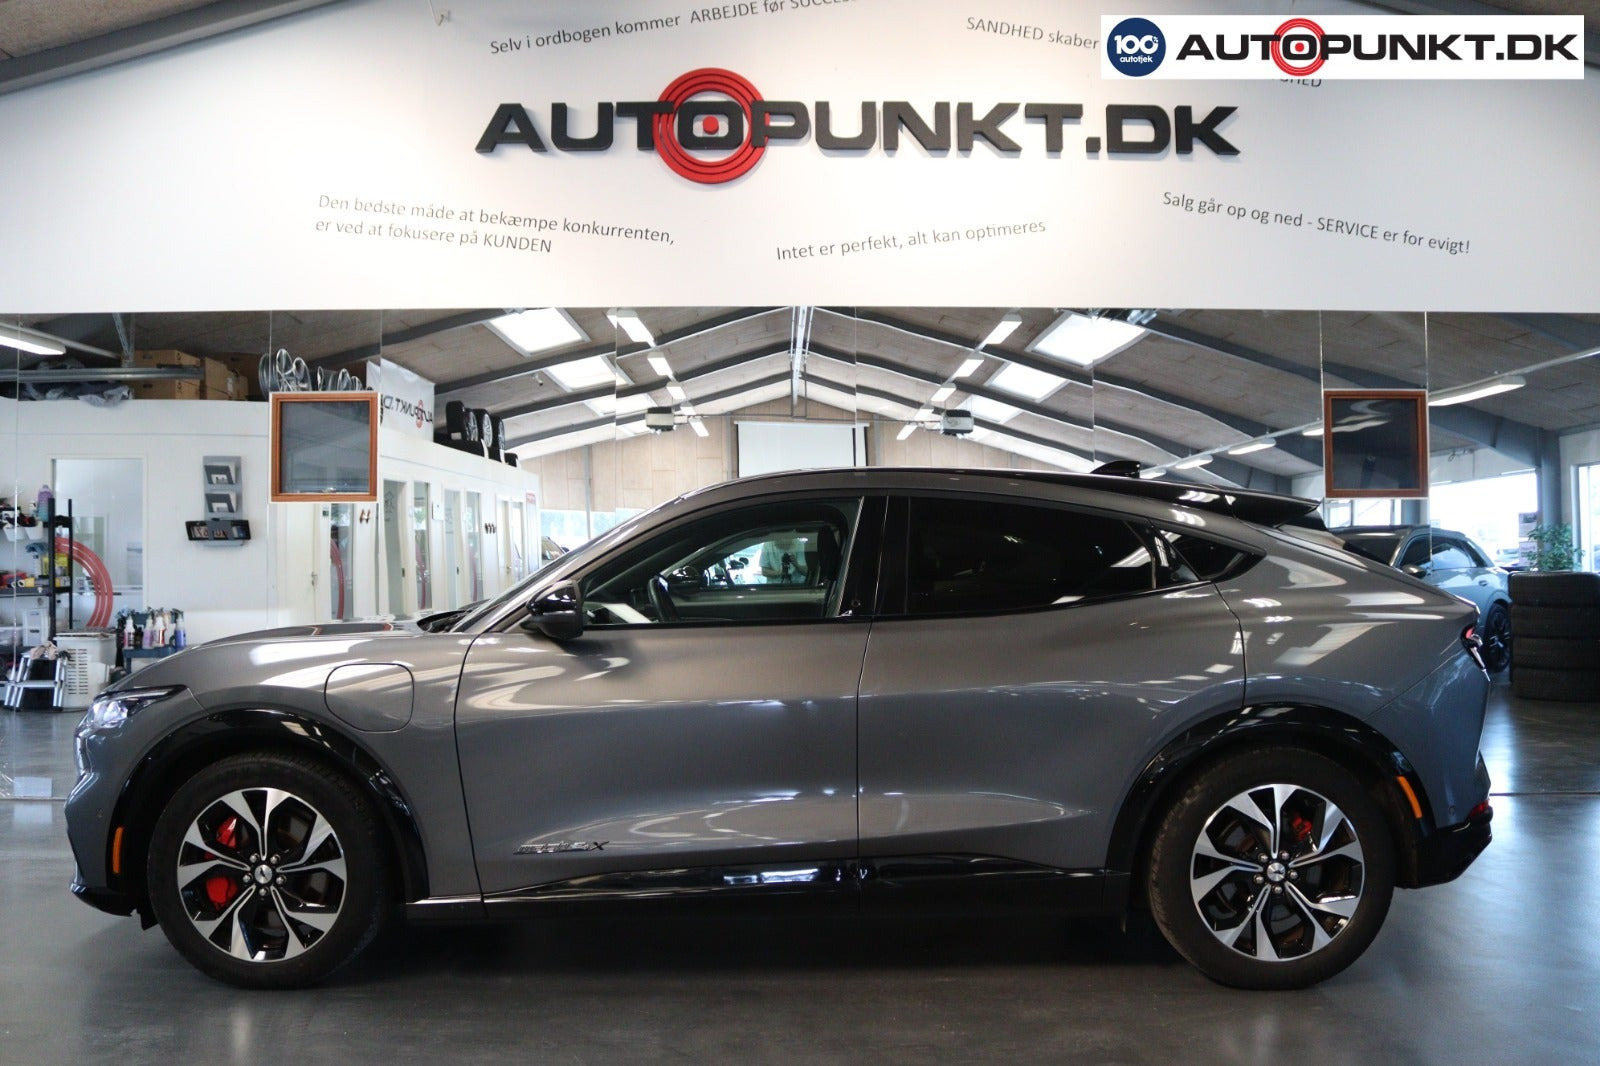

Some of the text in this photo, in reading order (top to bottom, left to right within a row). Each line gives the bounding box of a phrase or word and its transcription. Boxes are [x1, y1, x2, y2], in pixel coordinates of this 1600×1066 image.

[490, 37, 522, 54] Selv
[526, 35, 531, 49] i
[535, 26, 611, 48] ordbogen
[615, 14, 681, 35] kommer
[690, 1, 759, 24] ARBEJDE
[762, 0, 785, 14] før
[966, 17, 1099, 50] SANDHED skaber
[475, 100, 1240, 156] AUTOPUNKT.DK
[315, 220, 552, 253] er ved at fokusere på KUNDEN
[319, 194, 675, 246] Den bedste måde at bekæmpe konkurrenten,
[776, 219, 1046, 261] Intet er perfekt, alt kan optimeres
[1162, 191, 1194, 212] Salg
[1197, 197, 1224, 215] går
[1226, 204, 1247, 220] op
[1250, 208, 1270, 225] og
[1273, 212, 1303, 228] ned
[1316, 216, 1379, 240] SERVICE
[1383, 229, 1399, 243] er
[1403, 230, 1425, 247] for
[1428, 236, 1470, 256] evigt!
